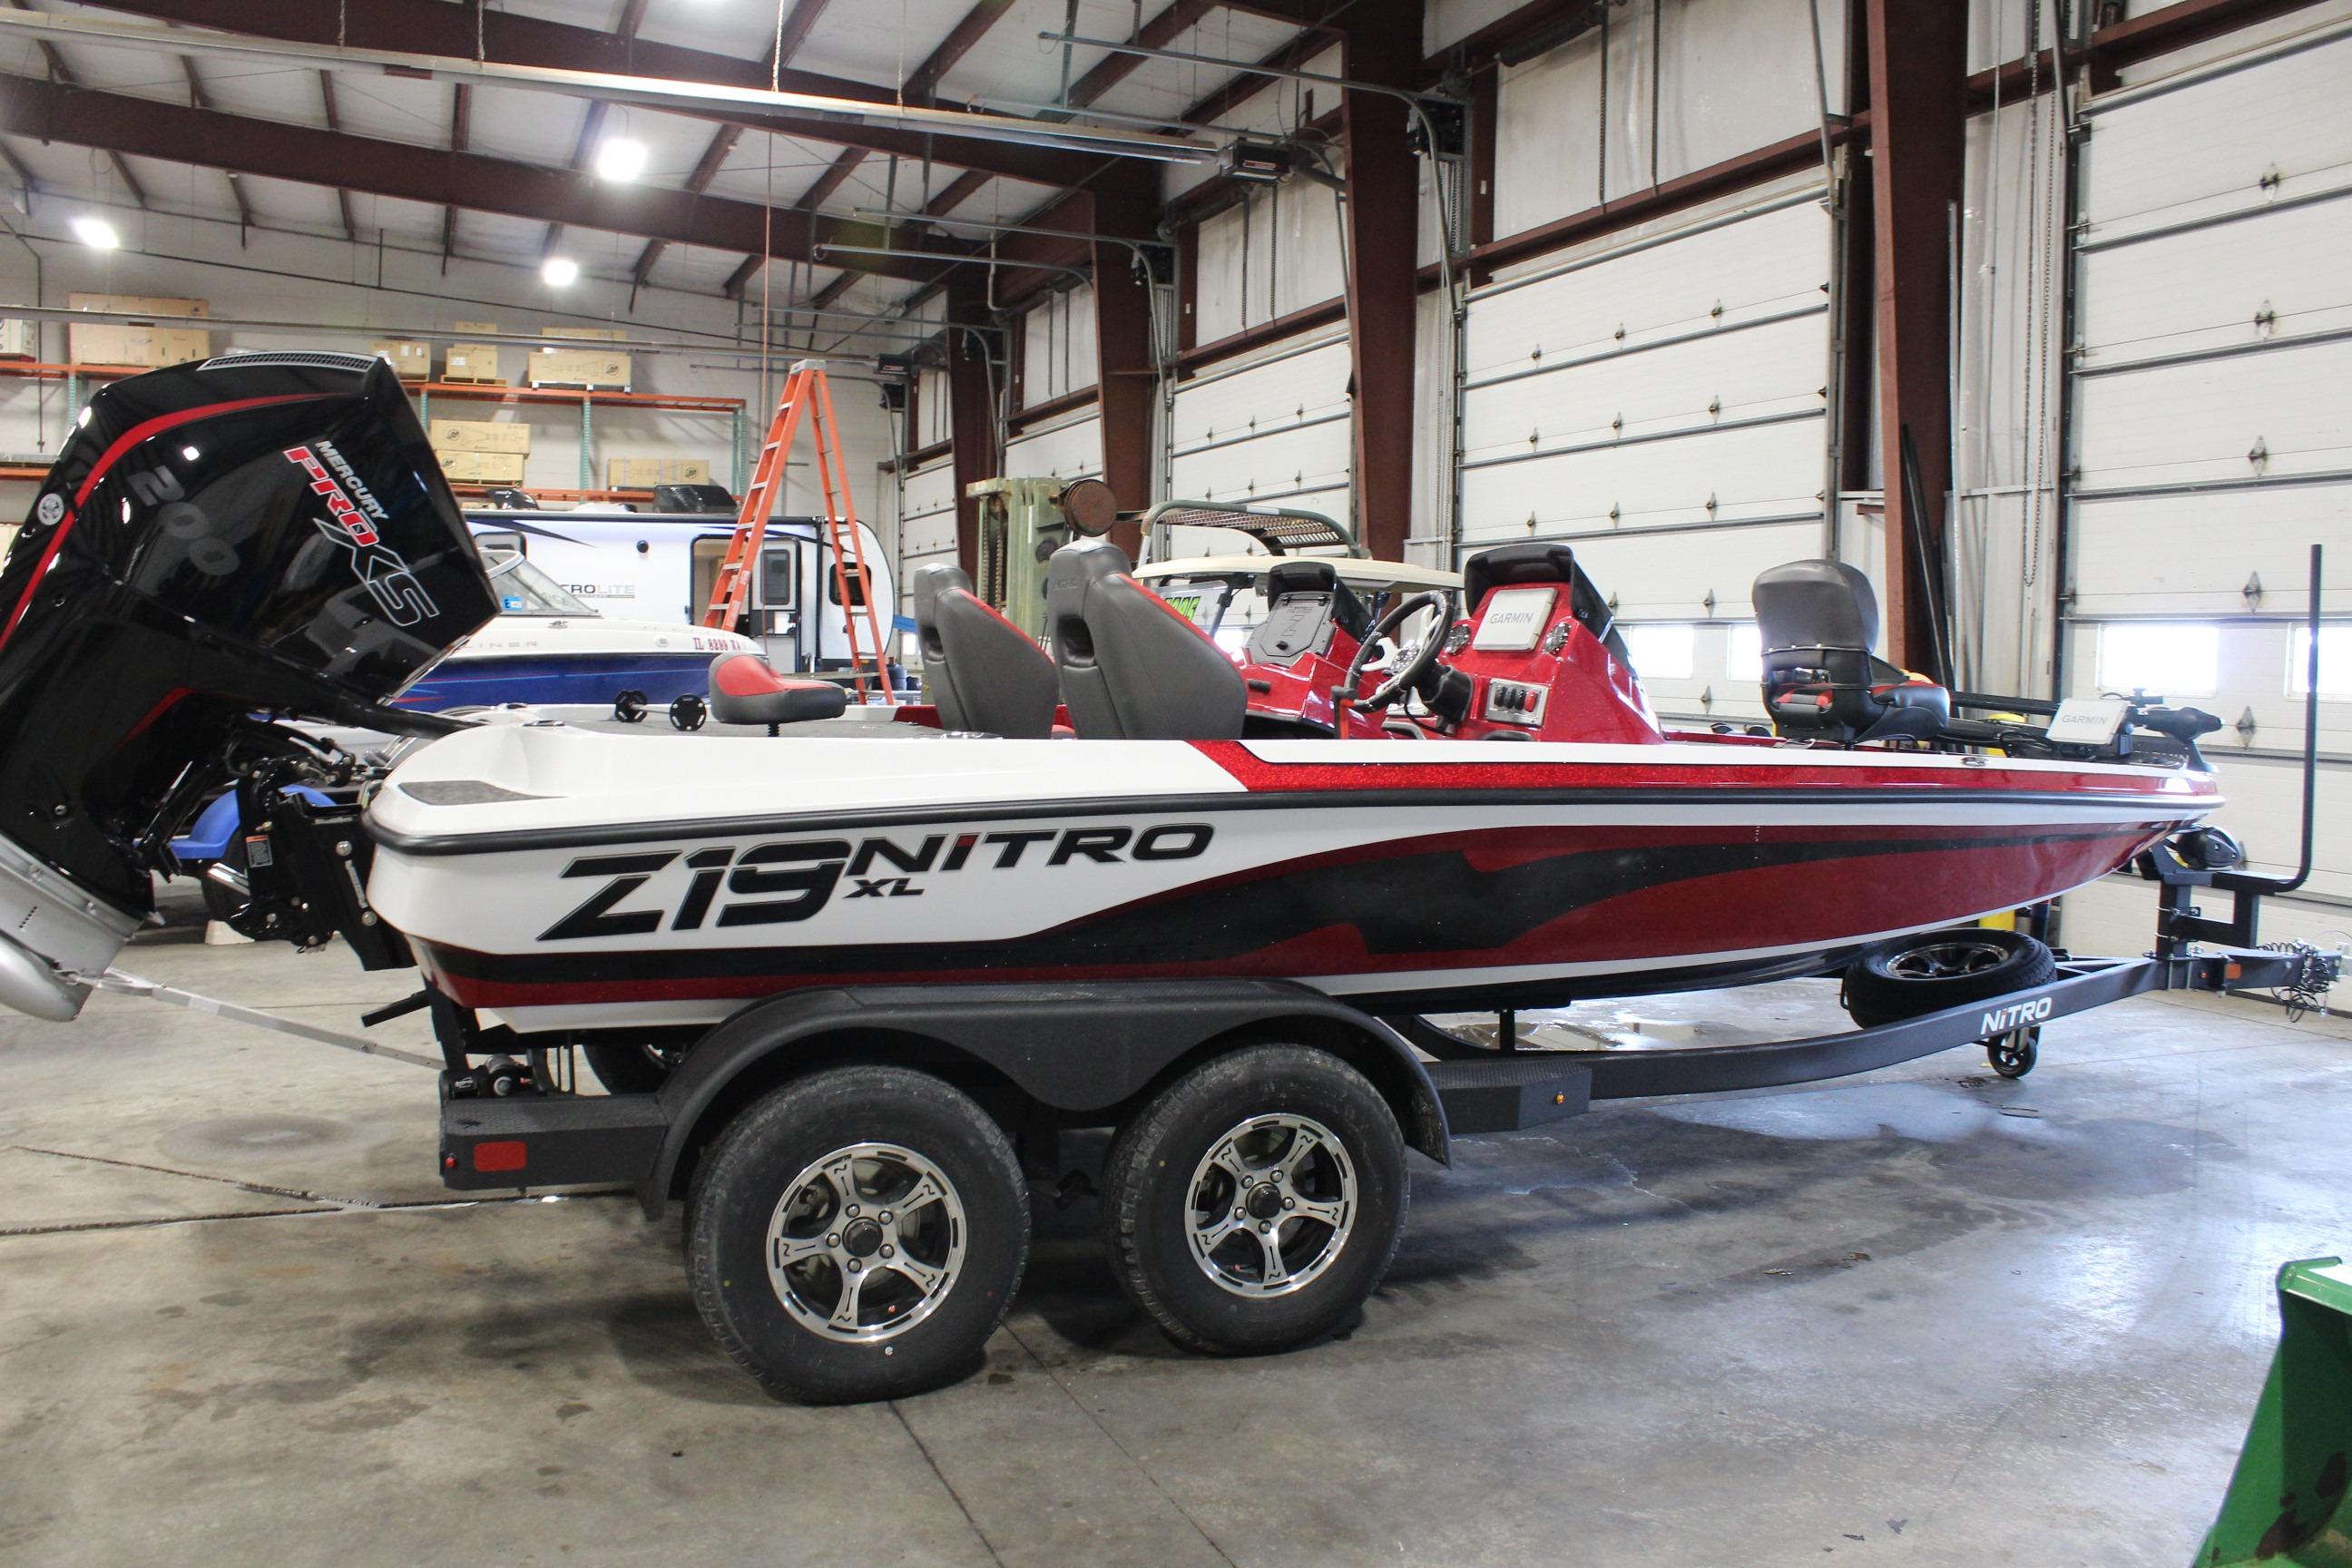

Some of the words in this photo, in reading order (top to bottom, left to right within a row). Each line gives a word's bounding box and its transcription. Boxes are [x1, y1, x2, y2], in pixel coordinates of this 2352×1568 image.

[126, 465, 240, 575] 200
[282, 446, 379, 547] PRO
[315, 440, 389, 519] MERCURY
[312, 509, 440, 626] XS
[1489, 612, 1534, 623] GARMIN
[2061, 714, 2109, 725] GARMIN
[535, 838, 852, 941] Z19
[843, 877, 925, 899] XL
